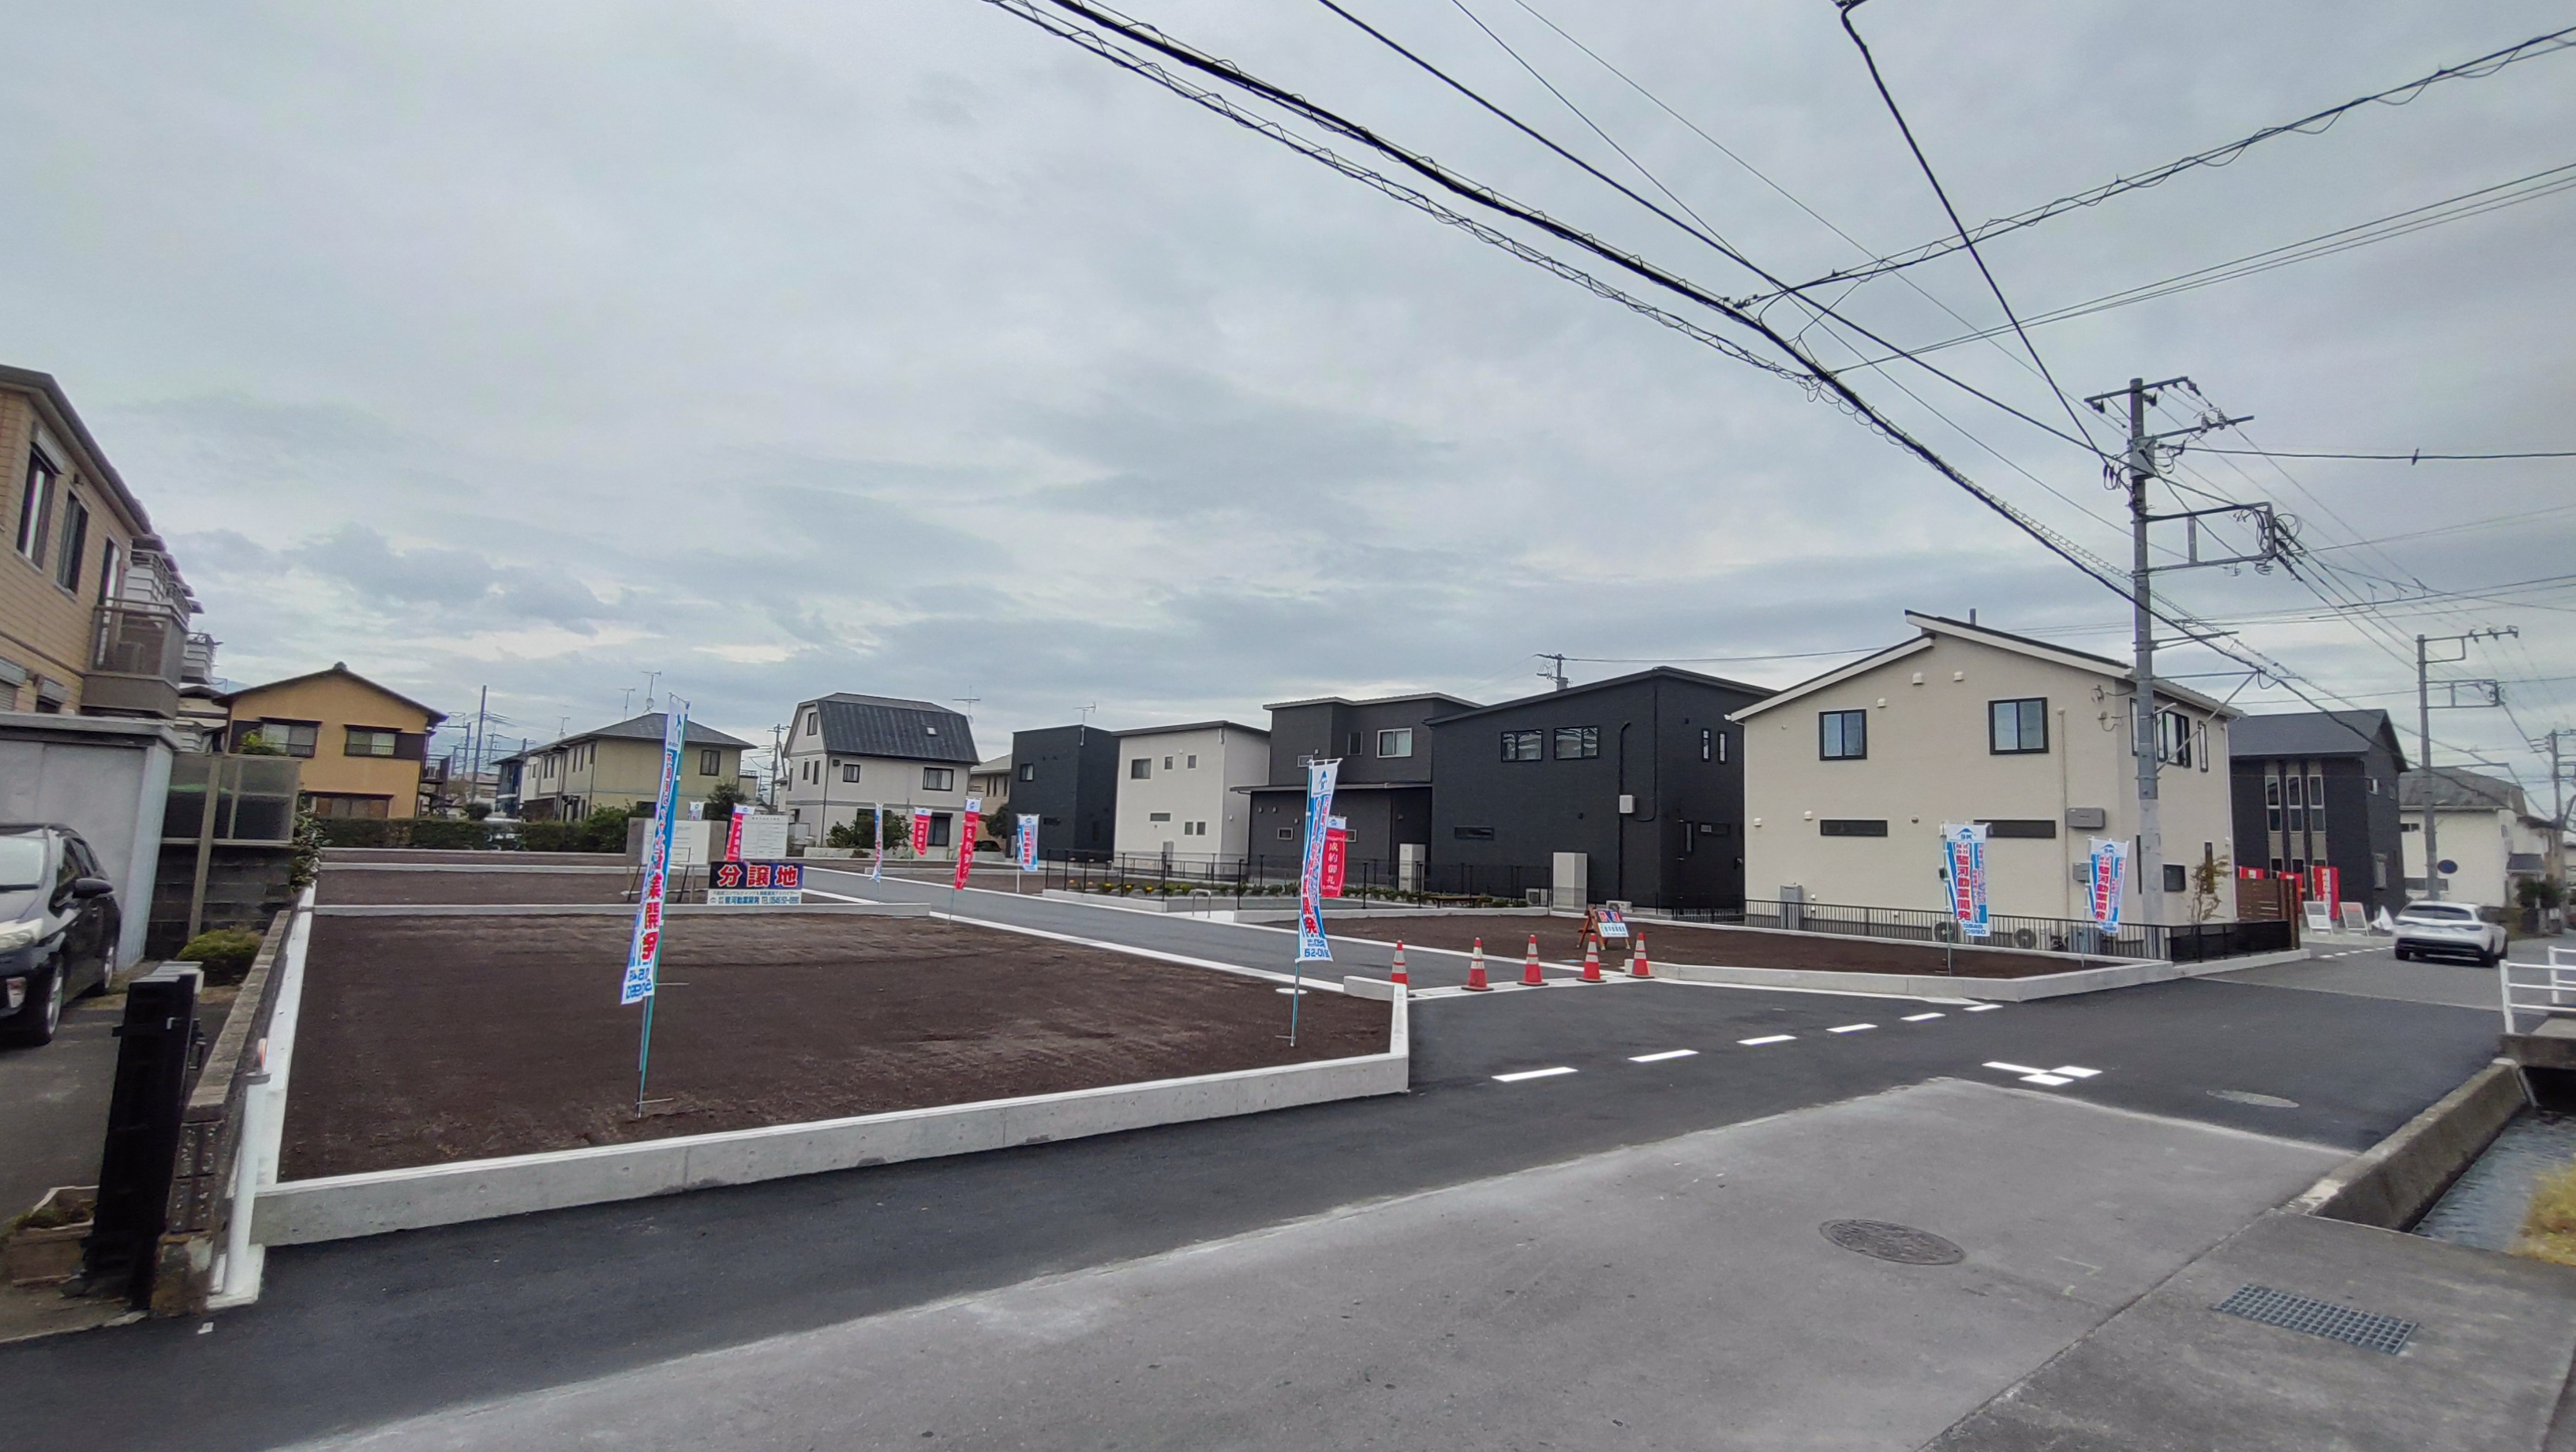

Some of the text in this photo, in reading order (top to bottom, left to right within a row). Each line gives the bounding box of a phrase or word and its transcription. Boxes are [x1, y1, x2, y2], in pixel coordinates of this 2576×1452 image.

[717, 864, 798, 888] 分譲地
[1327, 841, 1339, 884] 成約御礼
